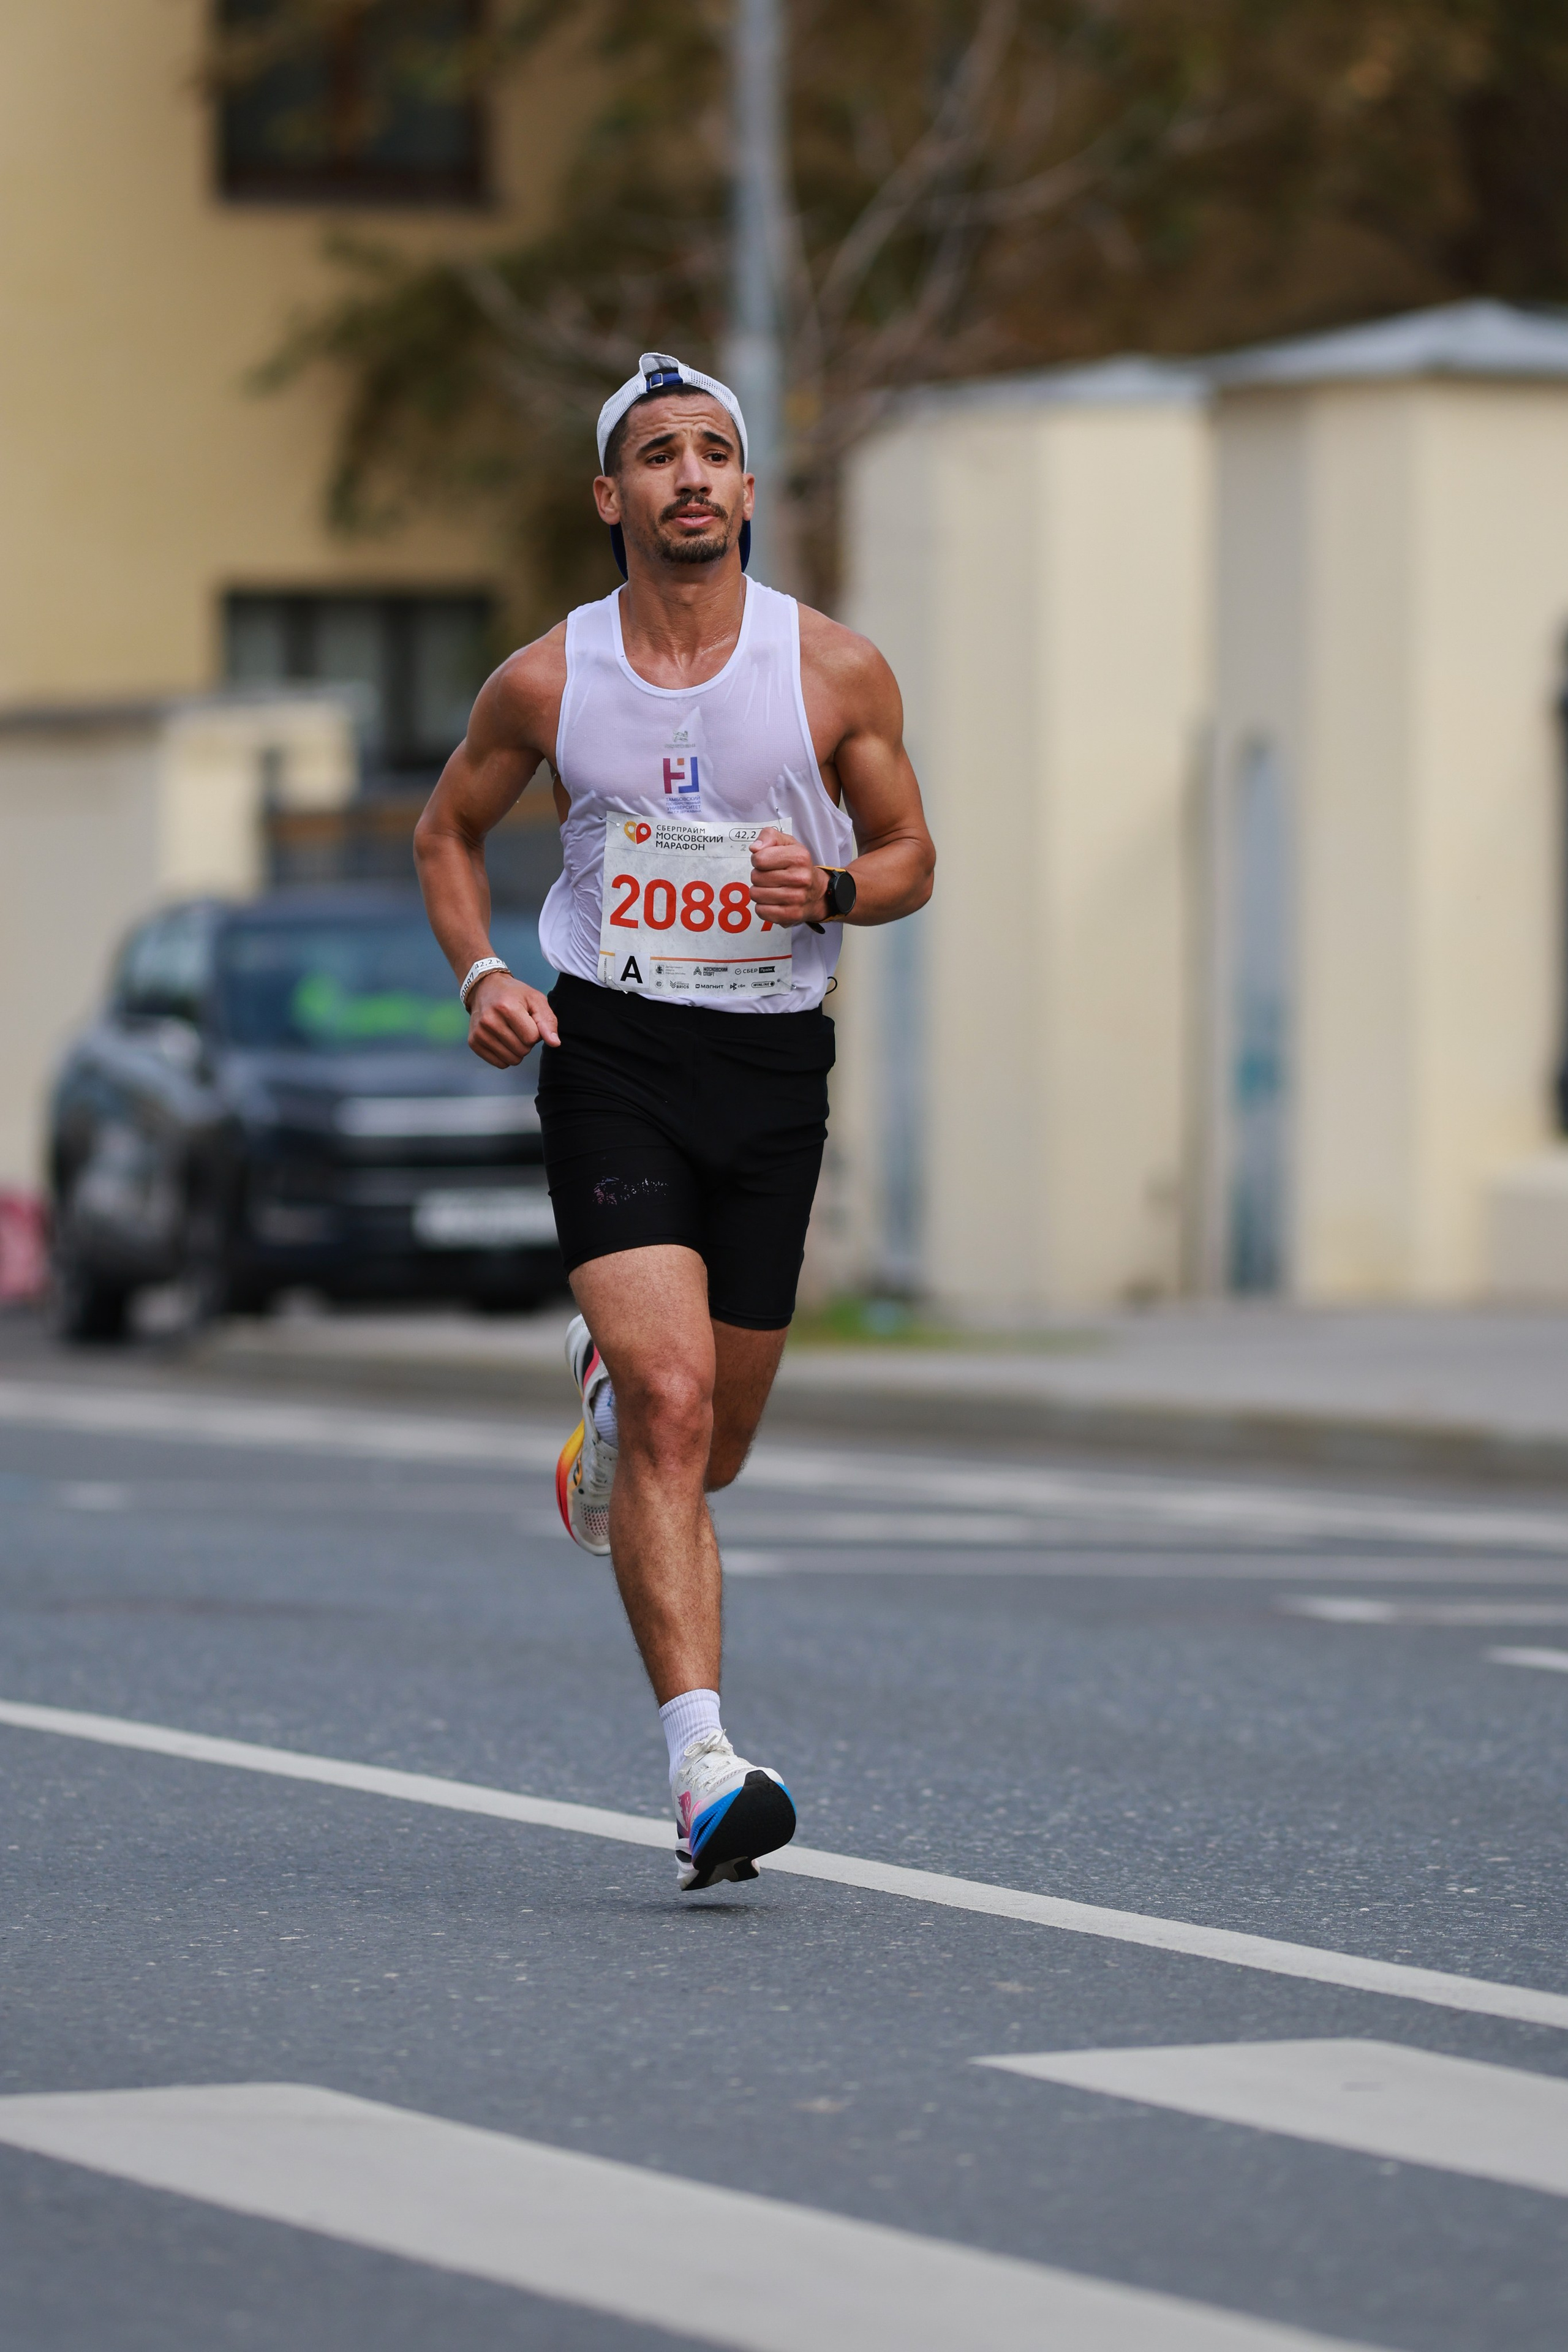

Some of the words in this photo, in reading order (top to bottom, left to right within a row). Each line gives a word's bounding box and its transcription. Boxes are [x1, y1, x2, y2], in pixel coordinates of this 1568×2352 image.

[656, 824, 705, 834] СБЕРПРАЙМ
[656, 832, 723, 843] МОСКОВСКИЙ
[735, 831, 756, 840] 42,2
[655, 840, 705, 851] МАРАФОН
[609, 873, 774, 934] 2088
[475, 959, 493, 970] 42,2
[620, 956, 643, 984] A
